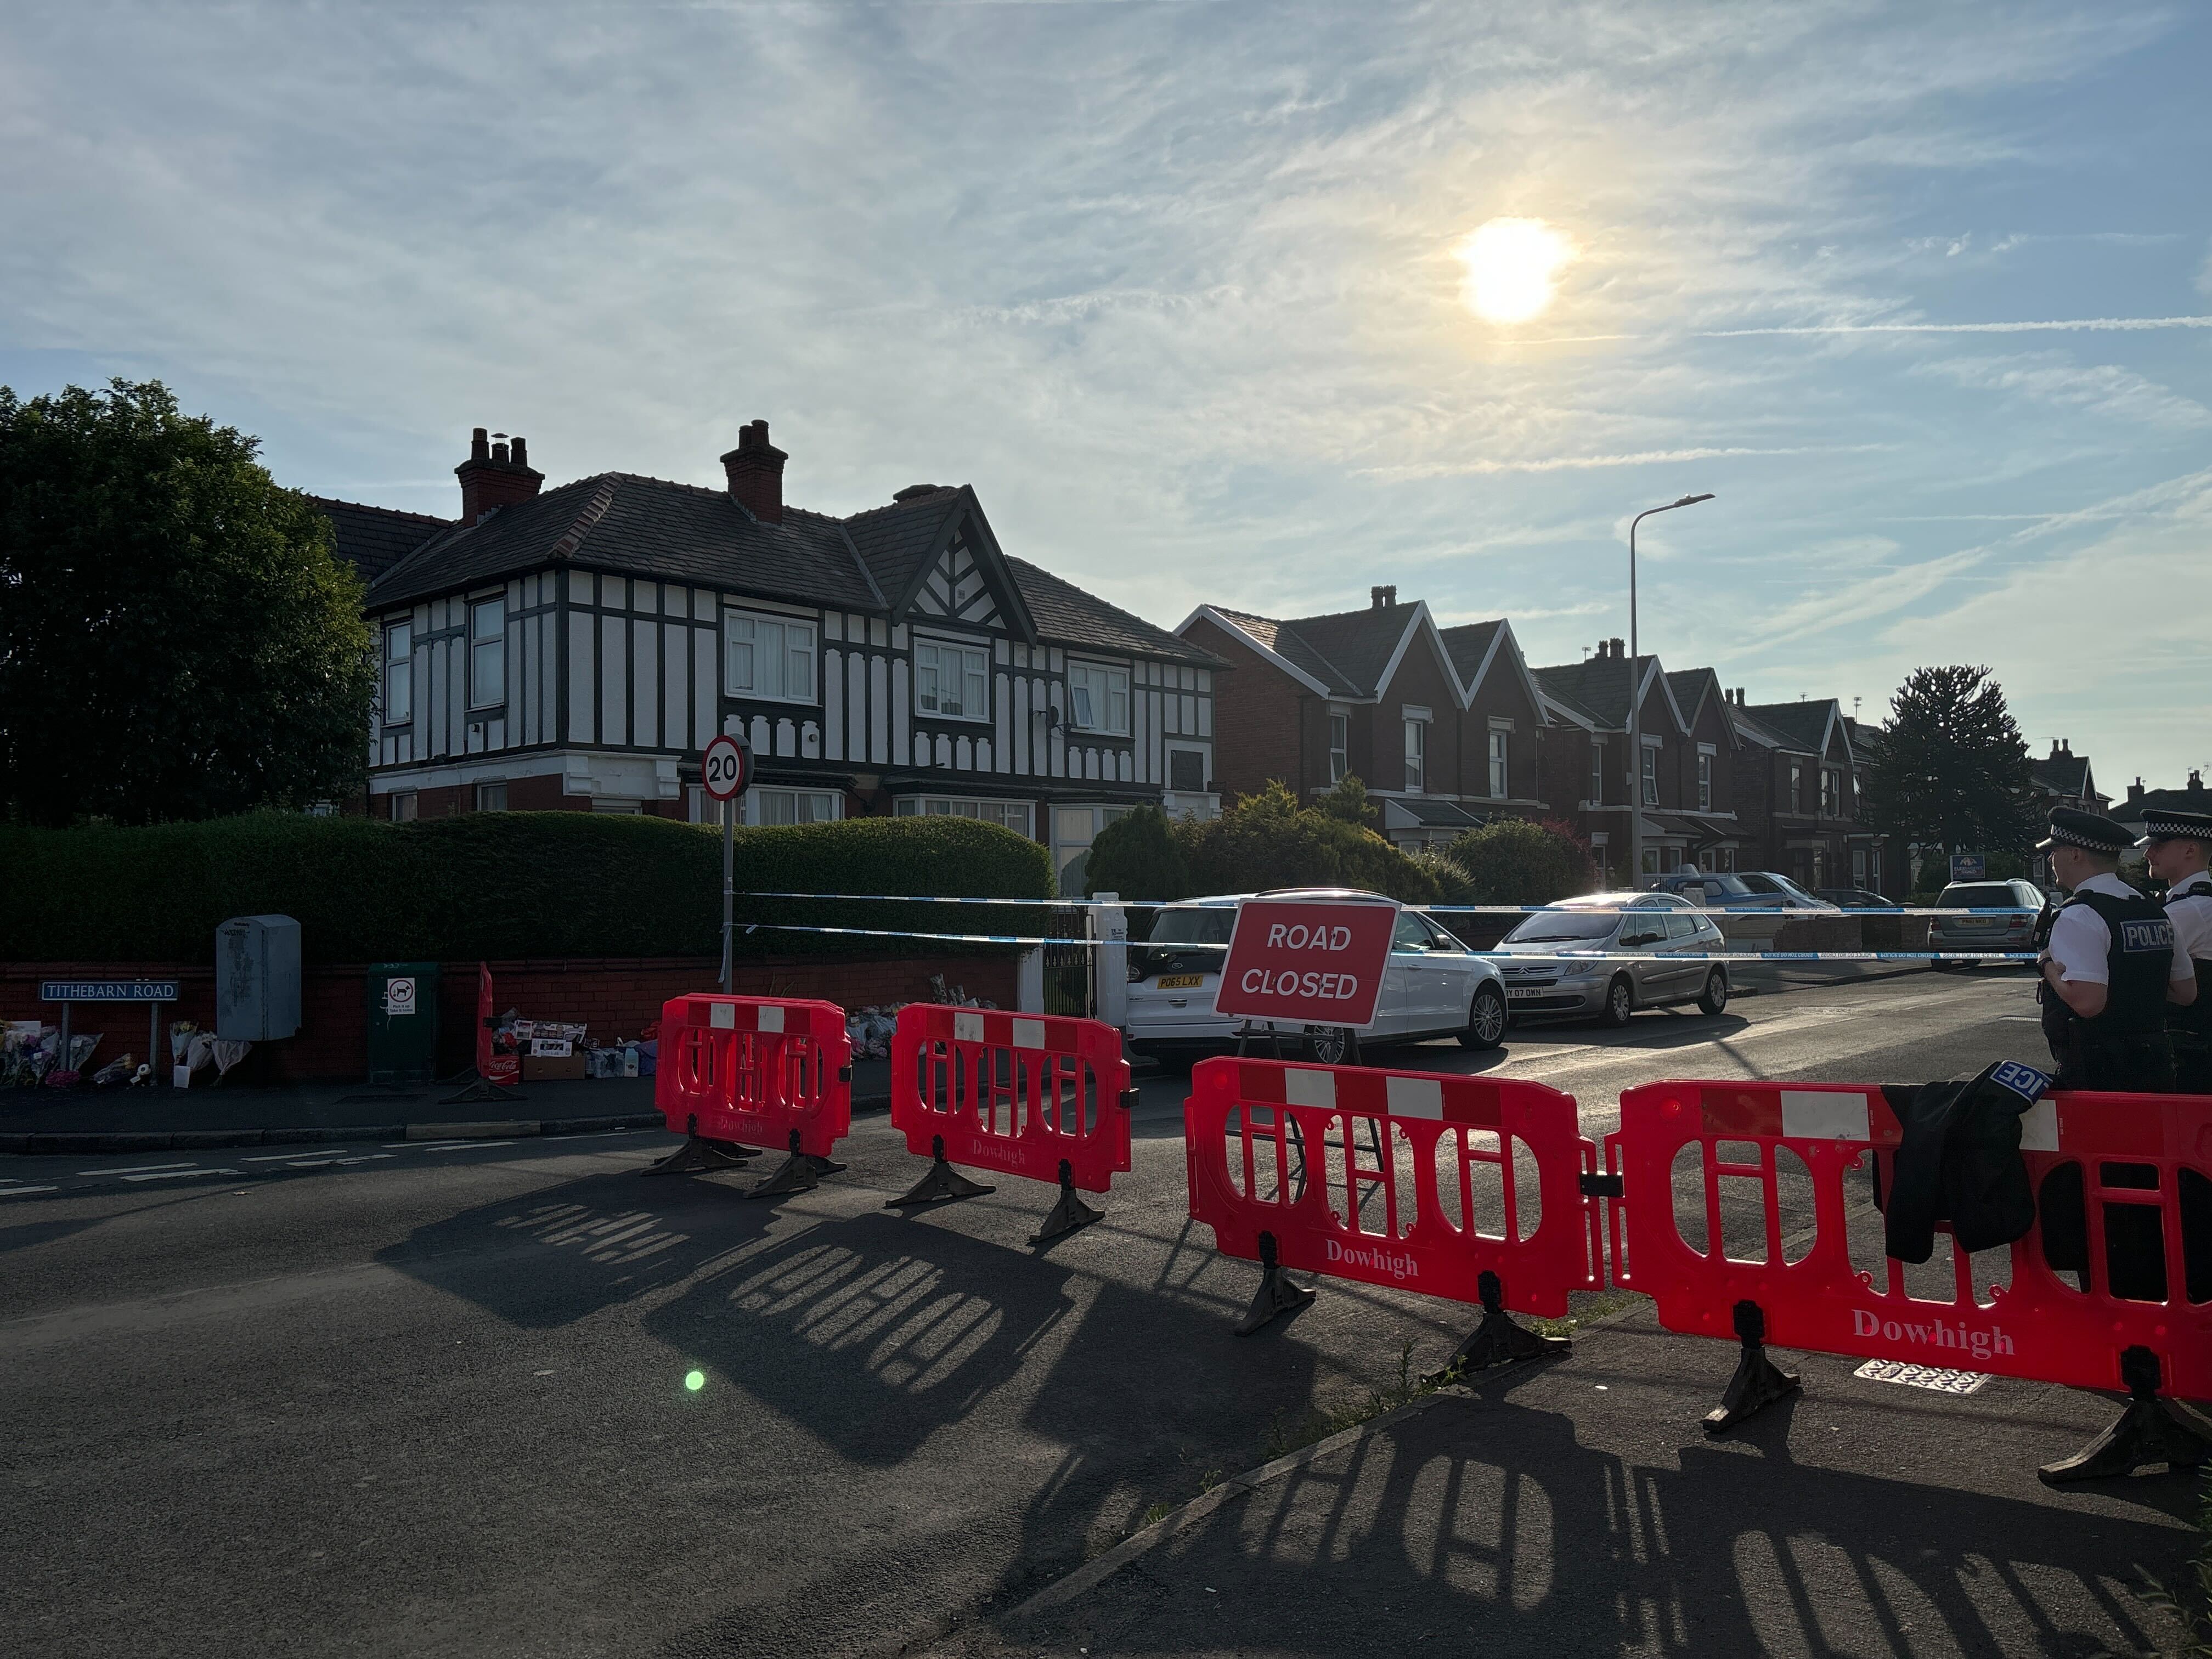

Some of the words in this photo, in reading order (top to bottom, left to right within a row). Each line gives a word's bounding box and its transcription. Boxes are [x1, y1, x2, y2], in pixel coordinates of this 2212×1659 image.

[708, 754, 737, 782] 20
[1267, 923, 1351, 951] ROAD
[2126, 924, 2174, 947] POLICE
[48, 984, 127, 997] TITHEBARN
[133, 984, 174, 997] ROAD
[1160, 977, 1180, 987] PO65
[1182, 977, 1200, 986] LXX
[1242, 968, 1358, 1000] CLOSED
[1999, 1063, 2050, 1096] ICE
[720, 1116, 763, 1137] Dowhigh
[973, 1139, 1025, 1169] Dowhigh
[1325, 1239, 1420, 1280] Dowhigh
[1851, 1308, 2016, 1360] Dowhigh
